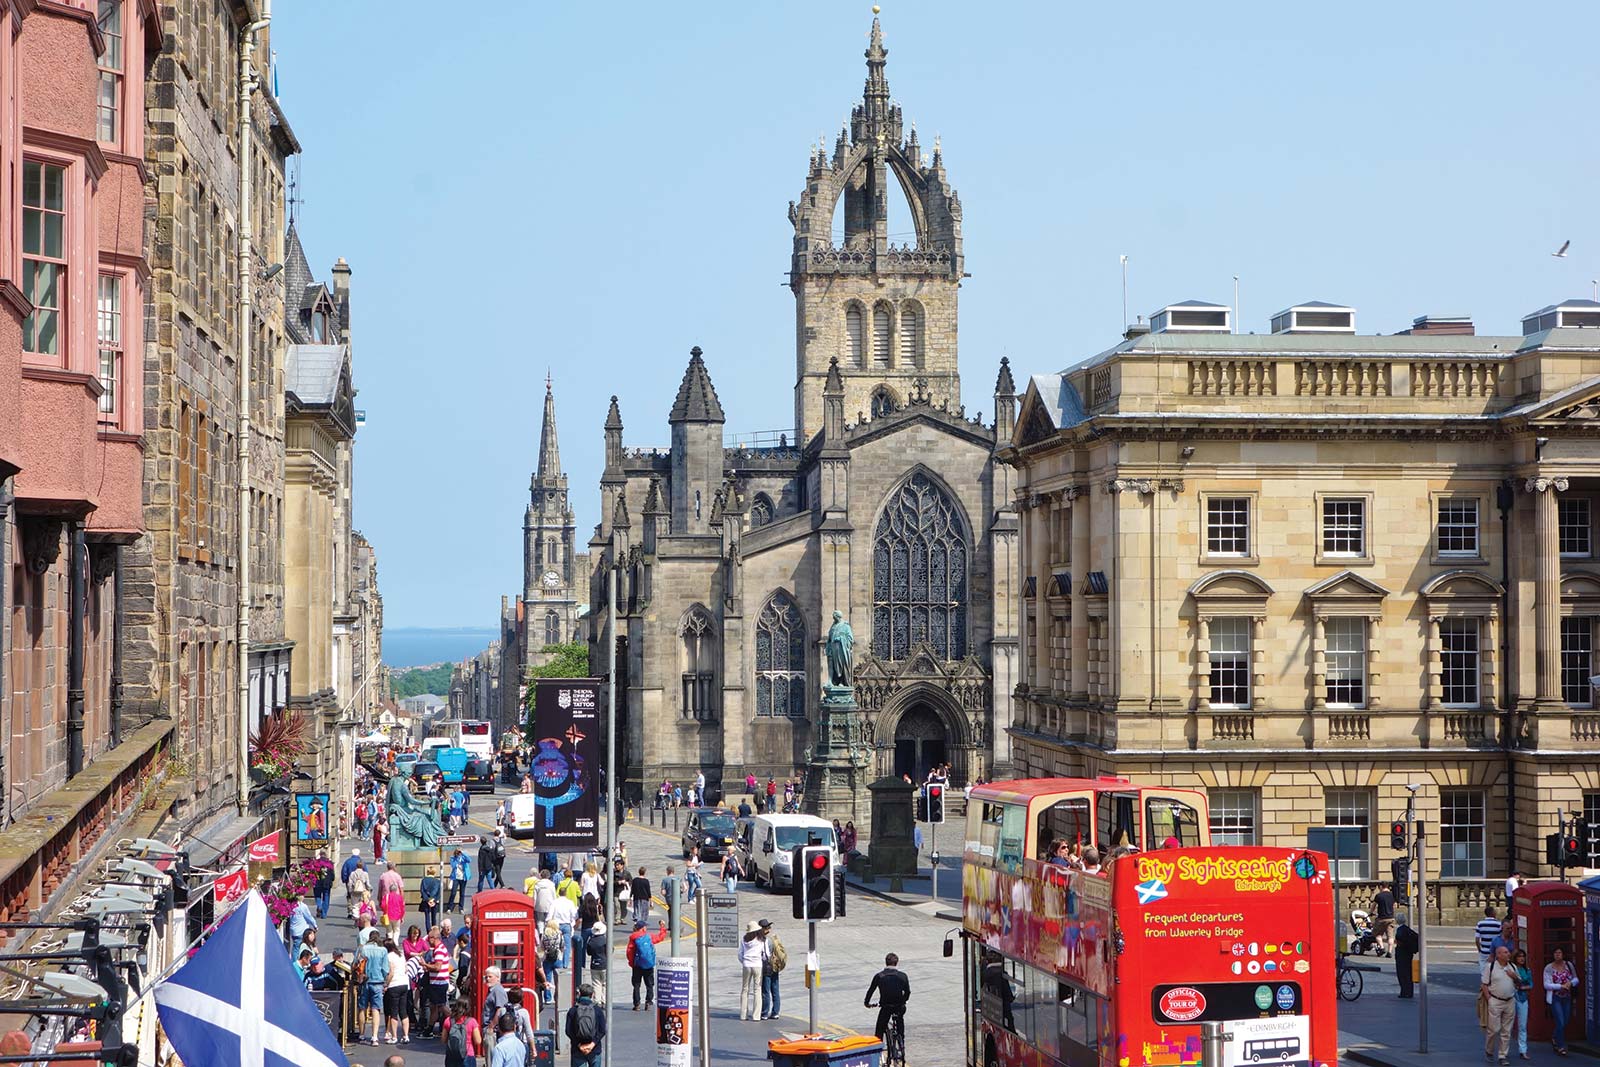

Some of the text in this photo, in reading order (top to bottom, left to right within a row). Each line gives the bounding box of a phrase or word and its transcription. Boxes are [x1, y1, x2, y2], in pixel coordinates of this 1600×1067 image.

[1139, 855, 1291, 885] City Sightseeing
[1234, 878, 1282, 893] Edinburgh
[1144, 912, 1244, 926] Frequent departures
[1145, 926, 1244, 939] from Waverley Bridge
[658, 960, 688, 968] Welcome!
[1168, 988, 1196, 998] OFFICIAL
[1166, 1008, 1201, 1020] EDINBURGH
